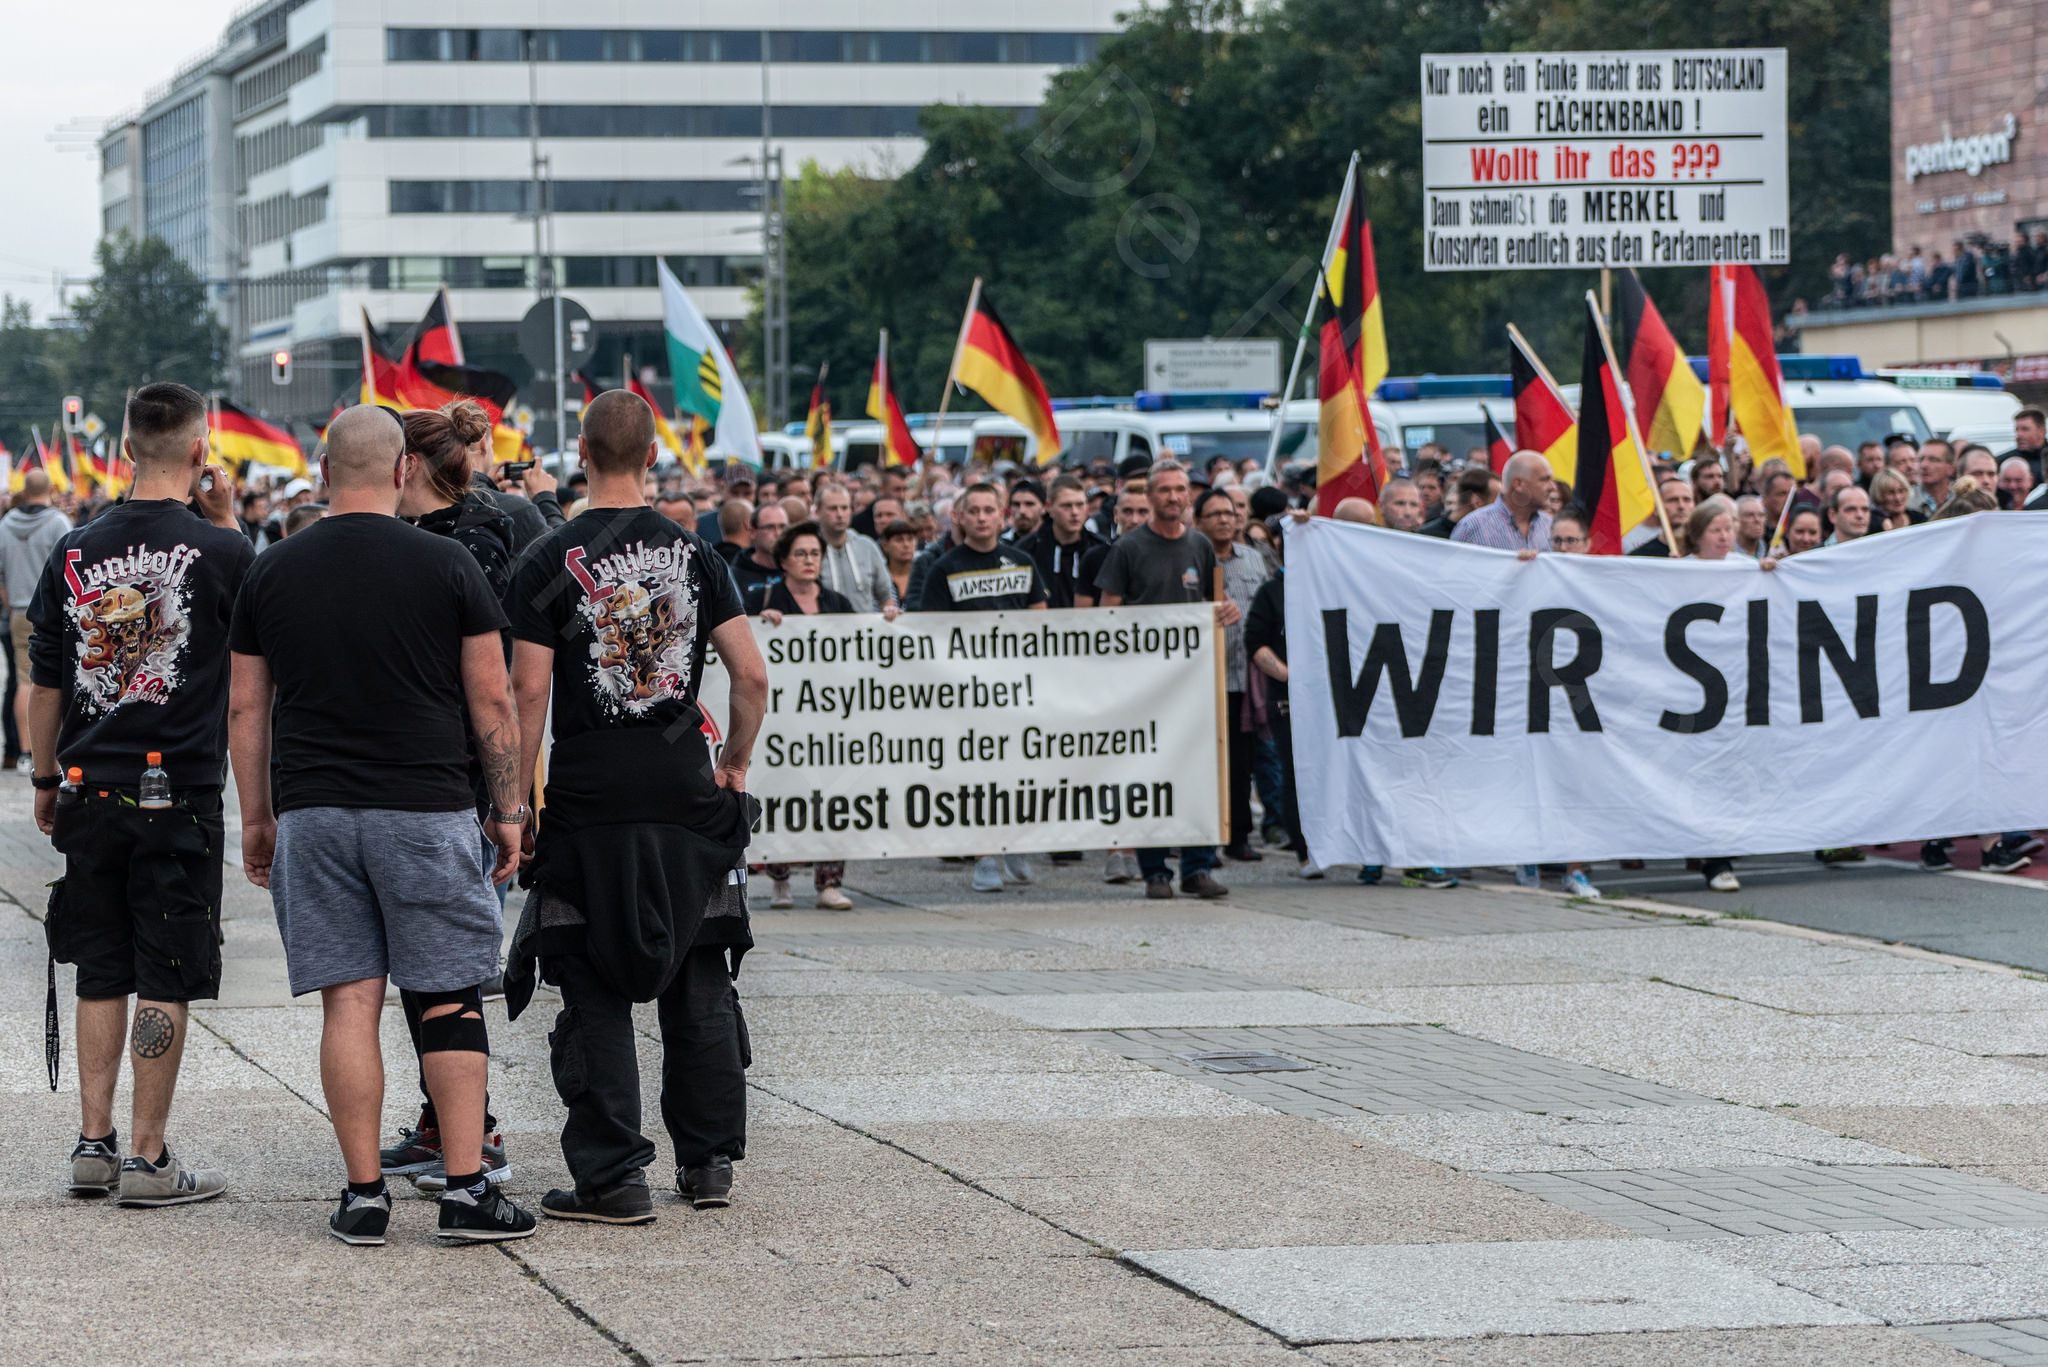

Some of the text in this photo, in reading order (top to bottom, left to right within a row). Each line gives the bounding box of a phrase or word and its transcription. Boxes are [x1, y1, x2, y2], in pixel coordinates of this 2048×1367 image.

[1426, 58, 1764, 95] Nur noch ein Funke macht aus DEUTSCHLAND
[1478, 102, 1508, 132] ein
[1536, 95, 1683, 131] FLÄCHENBRAND
[1471, 144, 1719, 181] Wollt ihr das ???
[1432, 196, 1460, 226] Dann
[1549, 193, 1567, 223] die
[1584, 190, 1678, 222] MERKEL
[1700, 187, 1725, 221] und
[1429, 231, 1498, 265] Konsorten
[1506, 232, 1569, 264] endlich
[1577, 237, 1605, 263] aus
[1611, 231, 1641, 261] den
[1652, 229, 1760, 262] Parlamenten
[959, 575, 1026, 596] AMSTAFF
[768, 626, 936, 669] sofortigen
[947, 622, 1201, 662] Aufnahmestopp
[1321, 586, 1991, 739] WIR SIND
[798, 673, 1034, 719] Asylbewerber!
[766, 731, 944, 769] Schließung
[957, 728, 1010, 763] der
[1022, 720, 1158, 760] Grenzen!
[905, 779, 1174, 830] Ostthüringen
